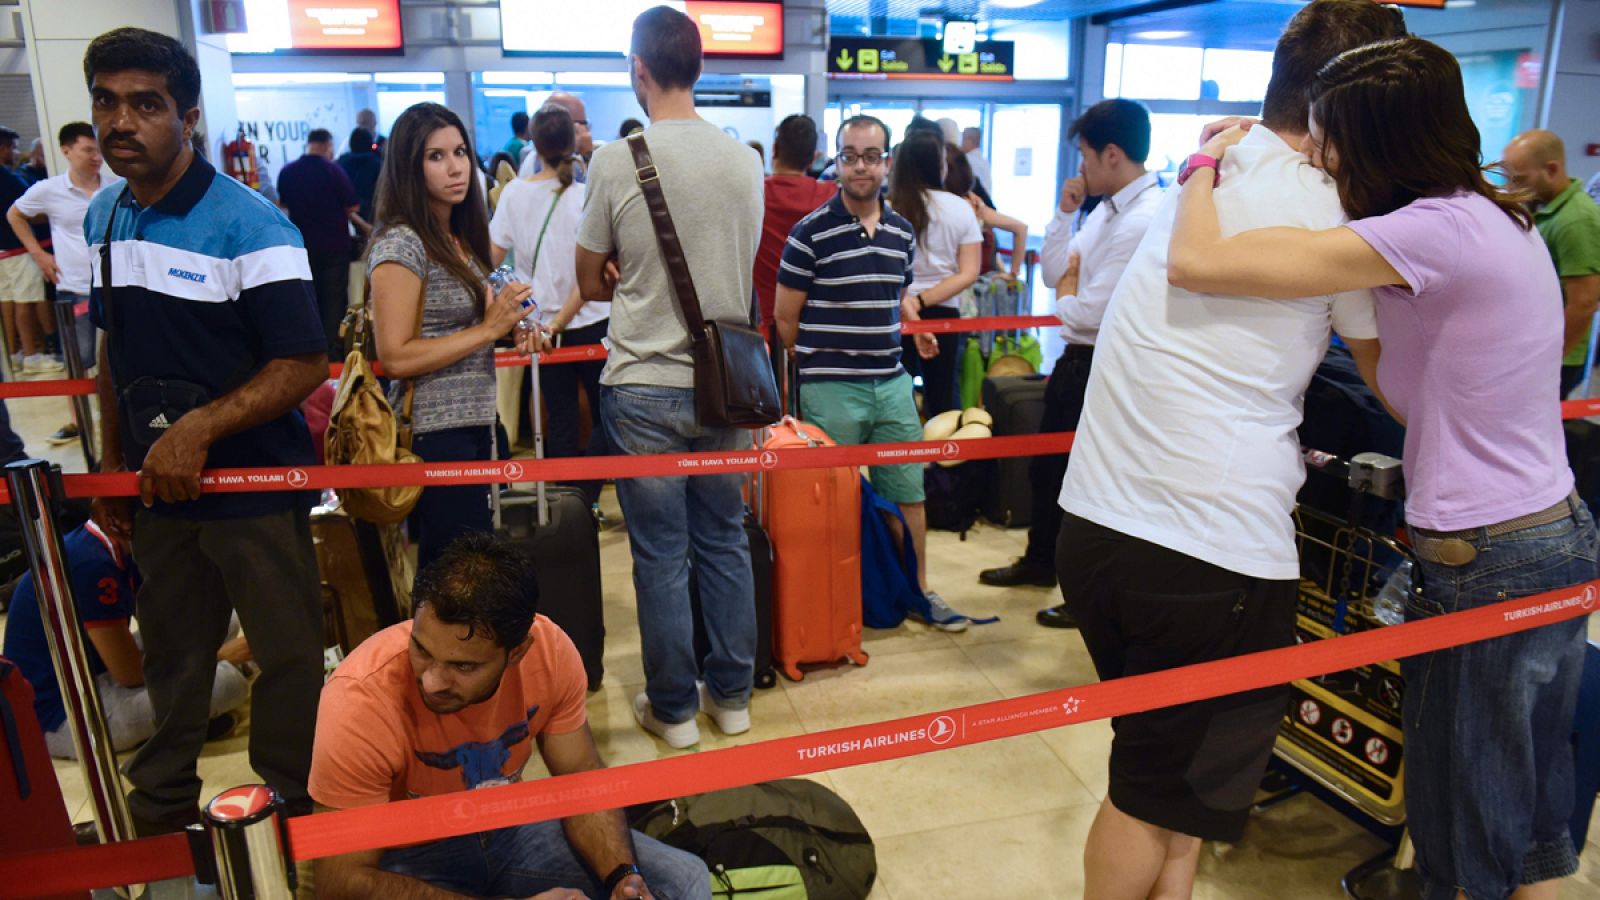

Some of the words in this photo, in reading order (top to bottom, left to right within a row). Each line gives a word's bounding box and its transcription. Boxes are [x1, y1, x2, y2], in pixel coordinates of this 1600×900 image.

[877, 449, 908, 458] TURKISH
[908, 447, 941, 456] AIRLINES
[701, 458, 724, 466] HAVA
[463, 467, 501, 476] AIRLINES
[219, 475, 245, 484] HAVA
[97, 577, 118, 605] 3
[1503, 605, 1543, 622] TURKISH
[1543, 595, 1582, 613] AIRLINES
[996, 712, 1029, 722] ALLIANCE
[1029, 705, 1058, 716] MEMBER
[797, 738, 862, 760] TURKISH
[863, 728, 926, 749] AIRLINES
